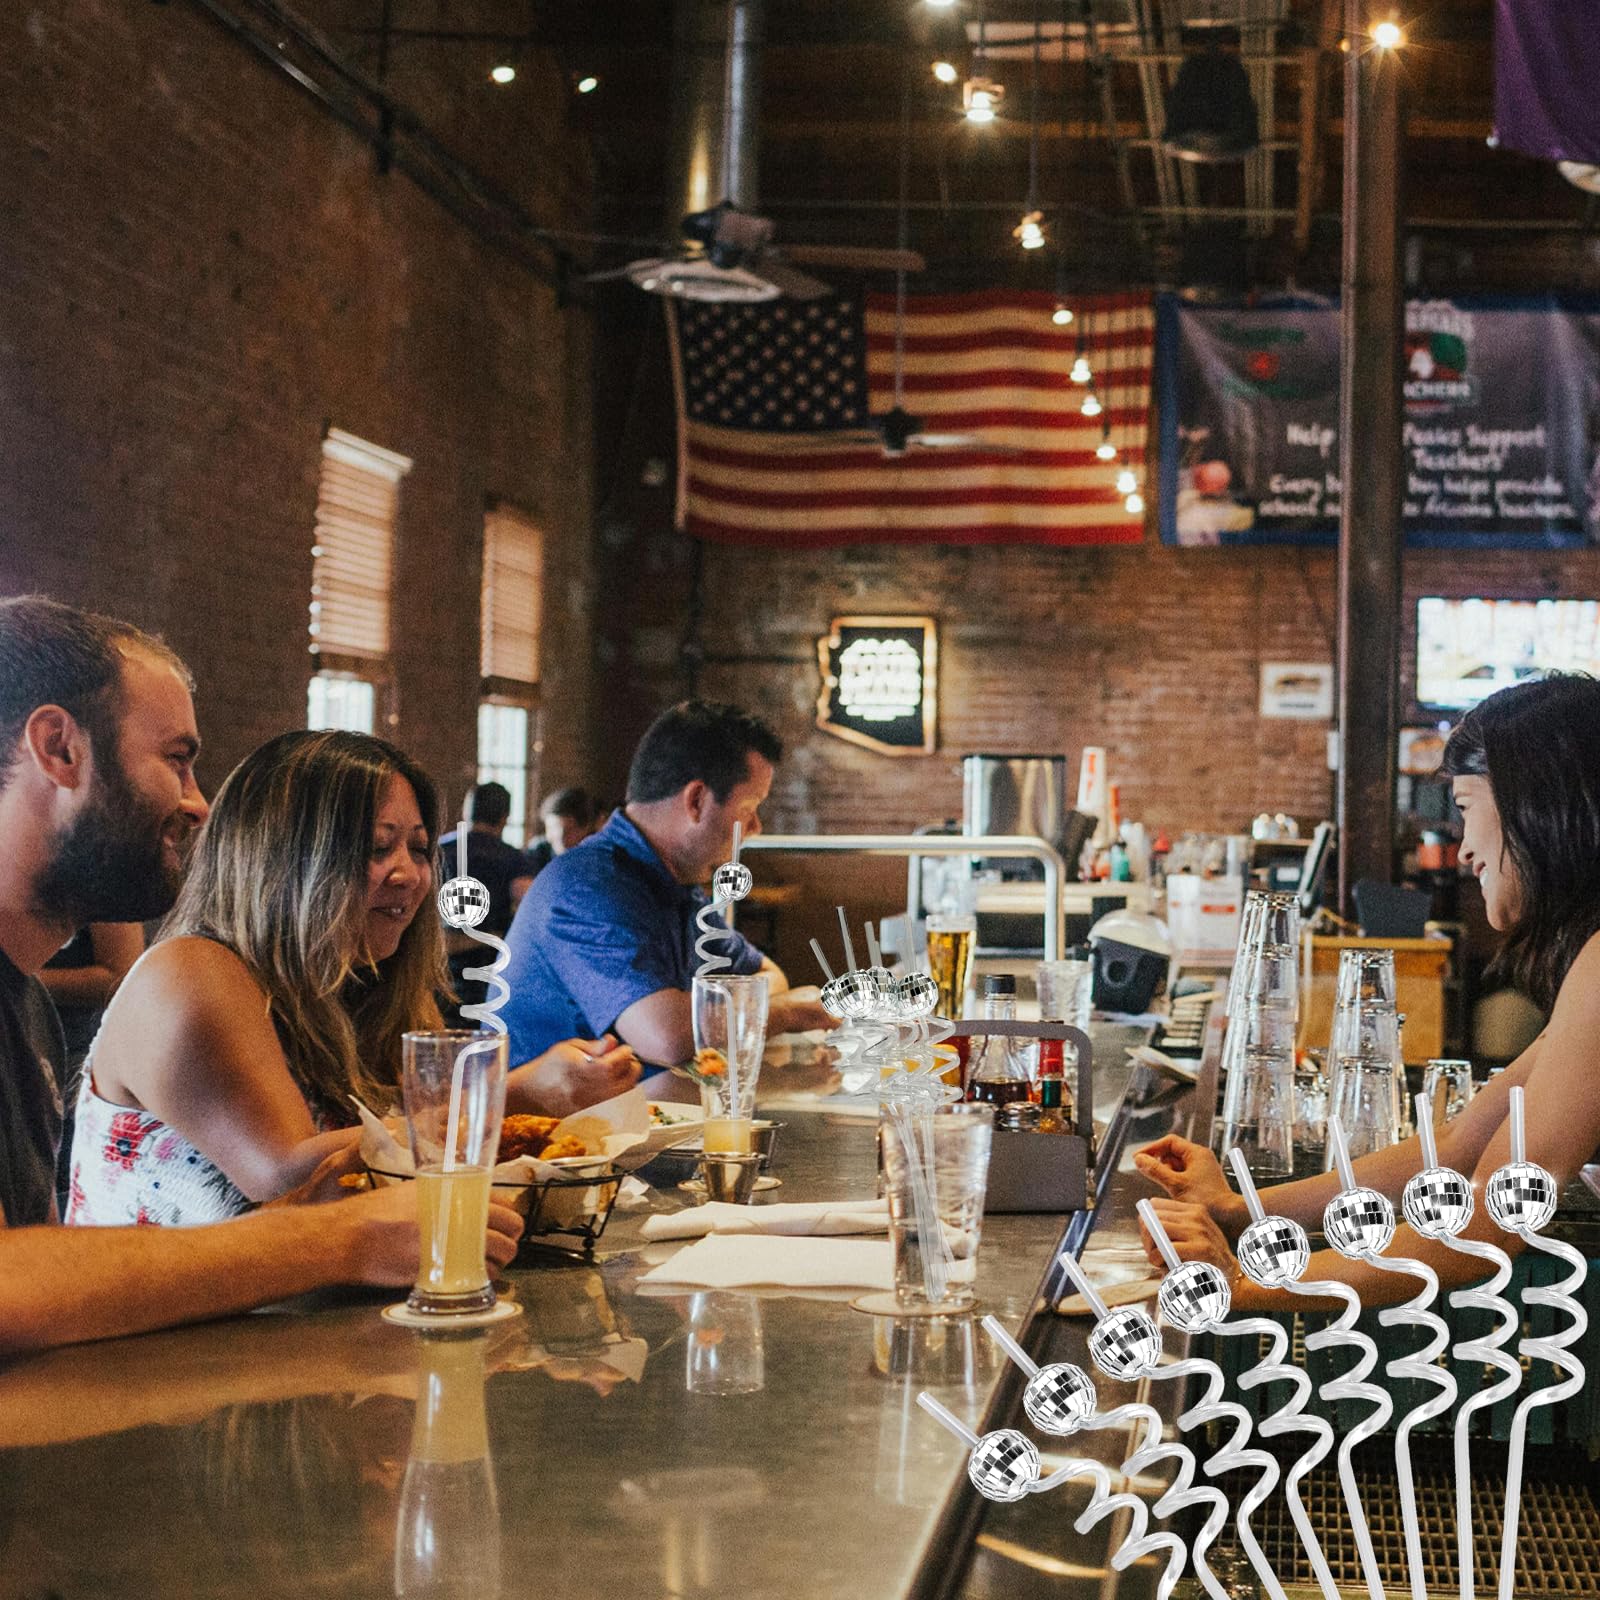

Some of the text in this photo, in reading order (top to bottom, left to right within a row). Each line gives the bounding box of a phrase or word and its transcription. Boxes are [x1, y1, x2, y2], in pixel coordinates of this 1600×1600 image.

[1287, 423, 1335, 457] Help
[1466, 424, 1545, 455] Support
[1443, 474, 1490, 501] helps
